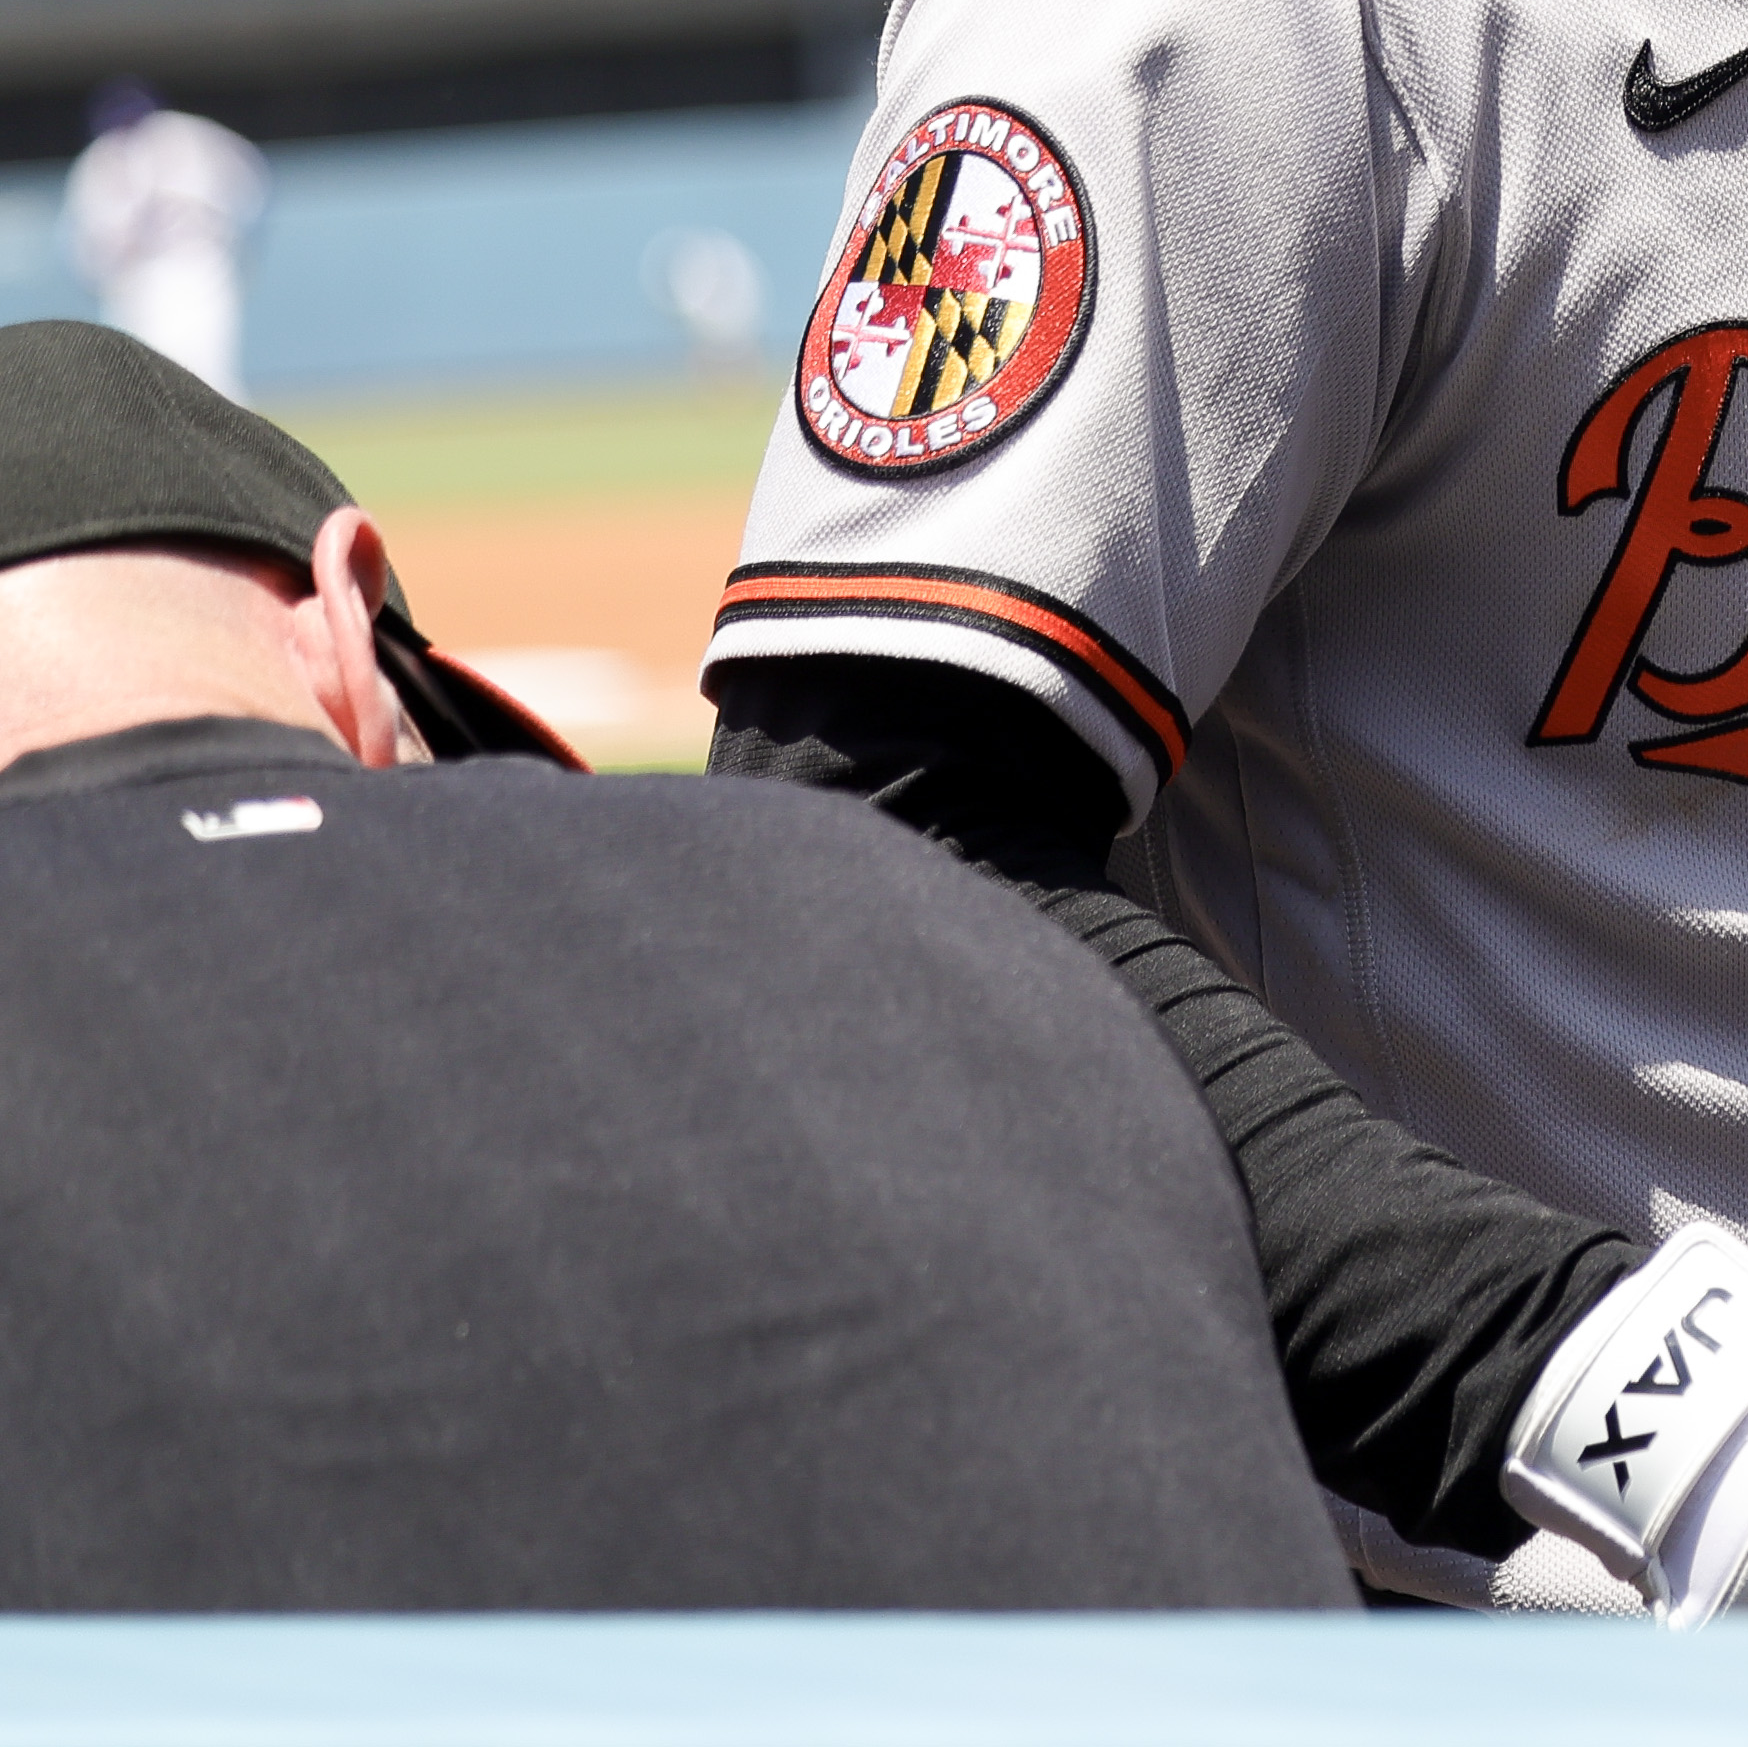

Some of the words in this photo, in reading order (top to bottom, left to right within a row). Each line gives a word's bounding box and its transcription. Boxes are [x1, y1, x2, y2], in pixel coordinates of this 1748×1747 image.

[859, 111, 1079, 247] BALTIMORE
[806, 375, 999, 458] ORIOLES
[1576, 1286, 1734, 1502] JAX
